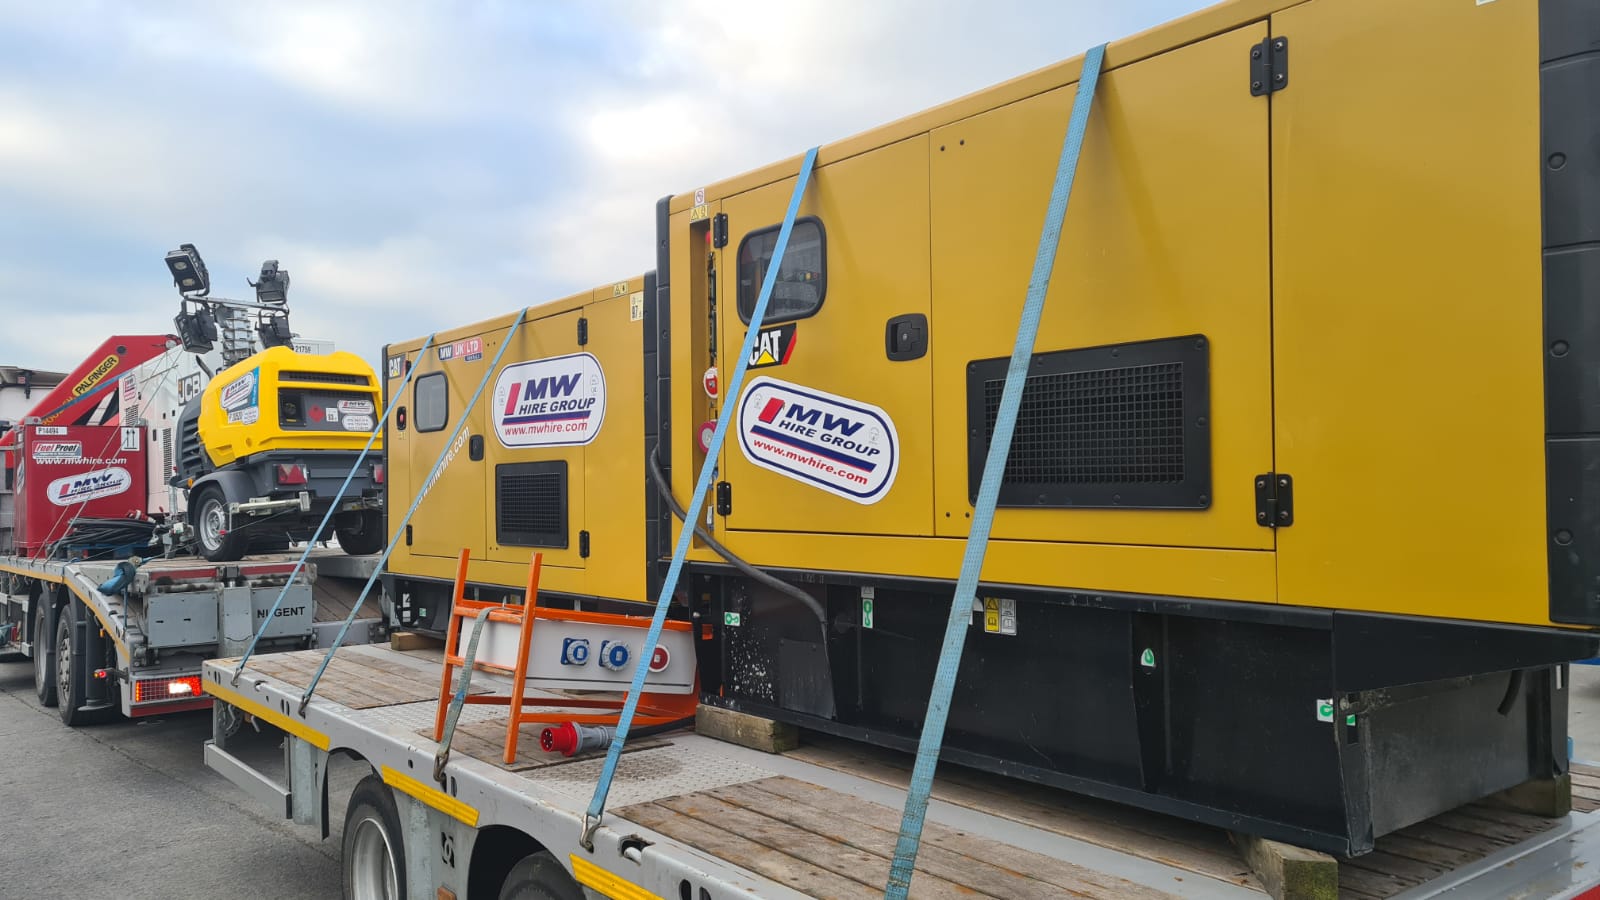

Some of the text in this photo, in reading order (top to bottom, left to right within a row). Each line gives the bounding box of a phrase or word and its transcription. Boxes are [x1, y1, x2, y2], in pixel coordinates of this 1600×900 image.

[440, 345, 452, 359] MW
[455, 343, 464, 355] UK
[467, 340, 479, 352] LTD
[749, 329, 782, 366] CAT
[75, 357, 117, 394] PALFINGER
[389, 357, 401, 377] CAT
[178, 373, 200, 405] JCB
[524, 373, 582, 401] MW
[519, 398, 596, 415] HIRE GROUP
[505, 420, 588, 436] www.mwhire.com
[785, 403, 865, 436] MW
[55, 444, 78, 452] Proof
[779, 419, 881, 457] HIRE GROUP
[35, 456, 127, 465] www.mwhire.com
[754, 439, 868, 485] www.mwhire.com
[74, 474, 112, 488] MW
